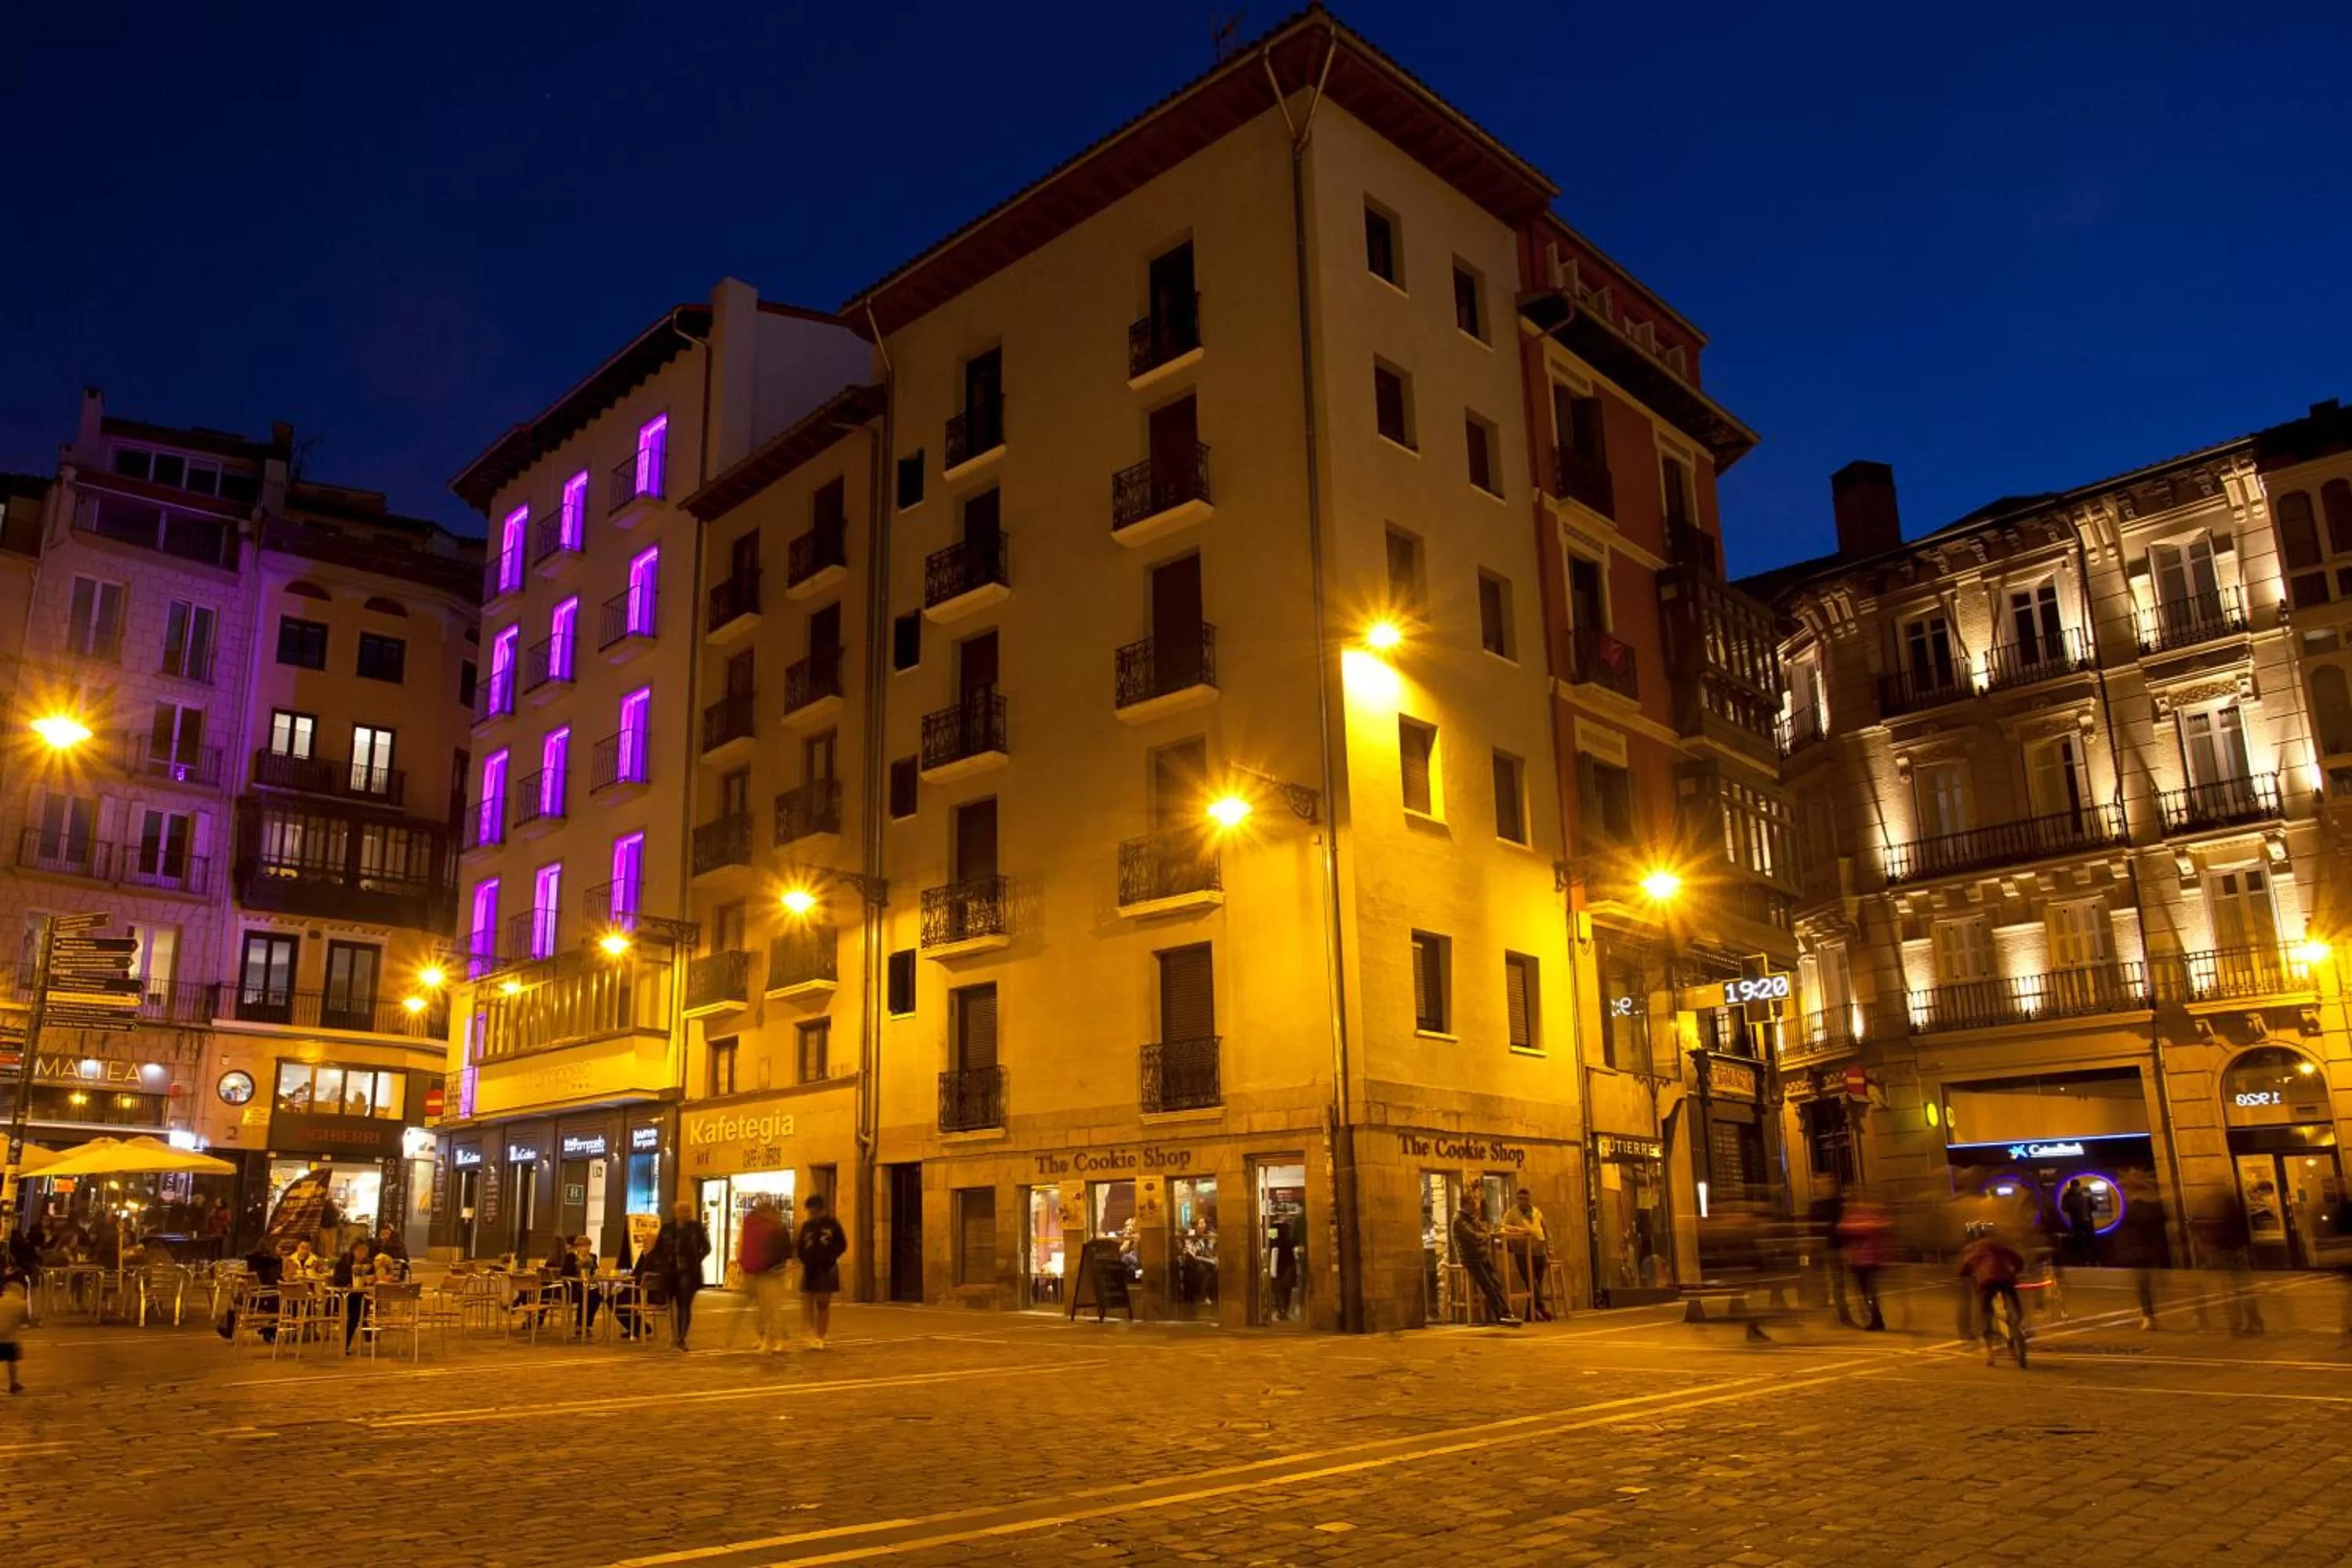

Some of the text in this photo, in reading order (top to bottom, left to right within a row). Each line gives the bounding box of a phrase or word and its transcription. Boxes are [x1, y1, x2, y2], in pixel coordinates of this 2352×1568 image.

[34, 1057, 142, 1083] MALTEA
[225, 1126, 238, 1141] 2
[294, 1127, 381, 1145] GIBERRI
[689, 1109, 794, 1145] Kafetegia
[1035, 1146, 1191, 1174] The Cookie Shop
[1398, 1134, 1525, 1168] The Cookie Shop
